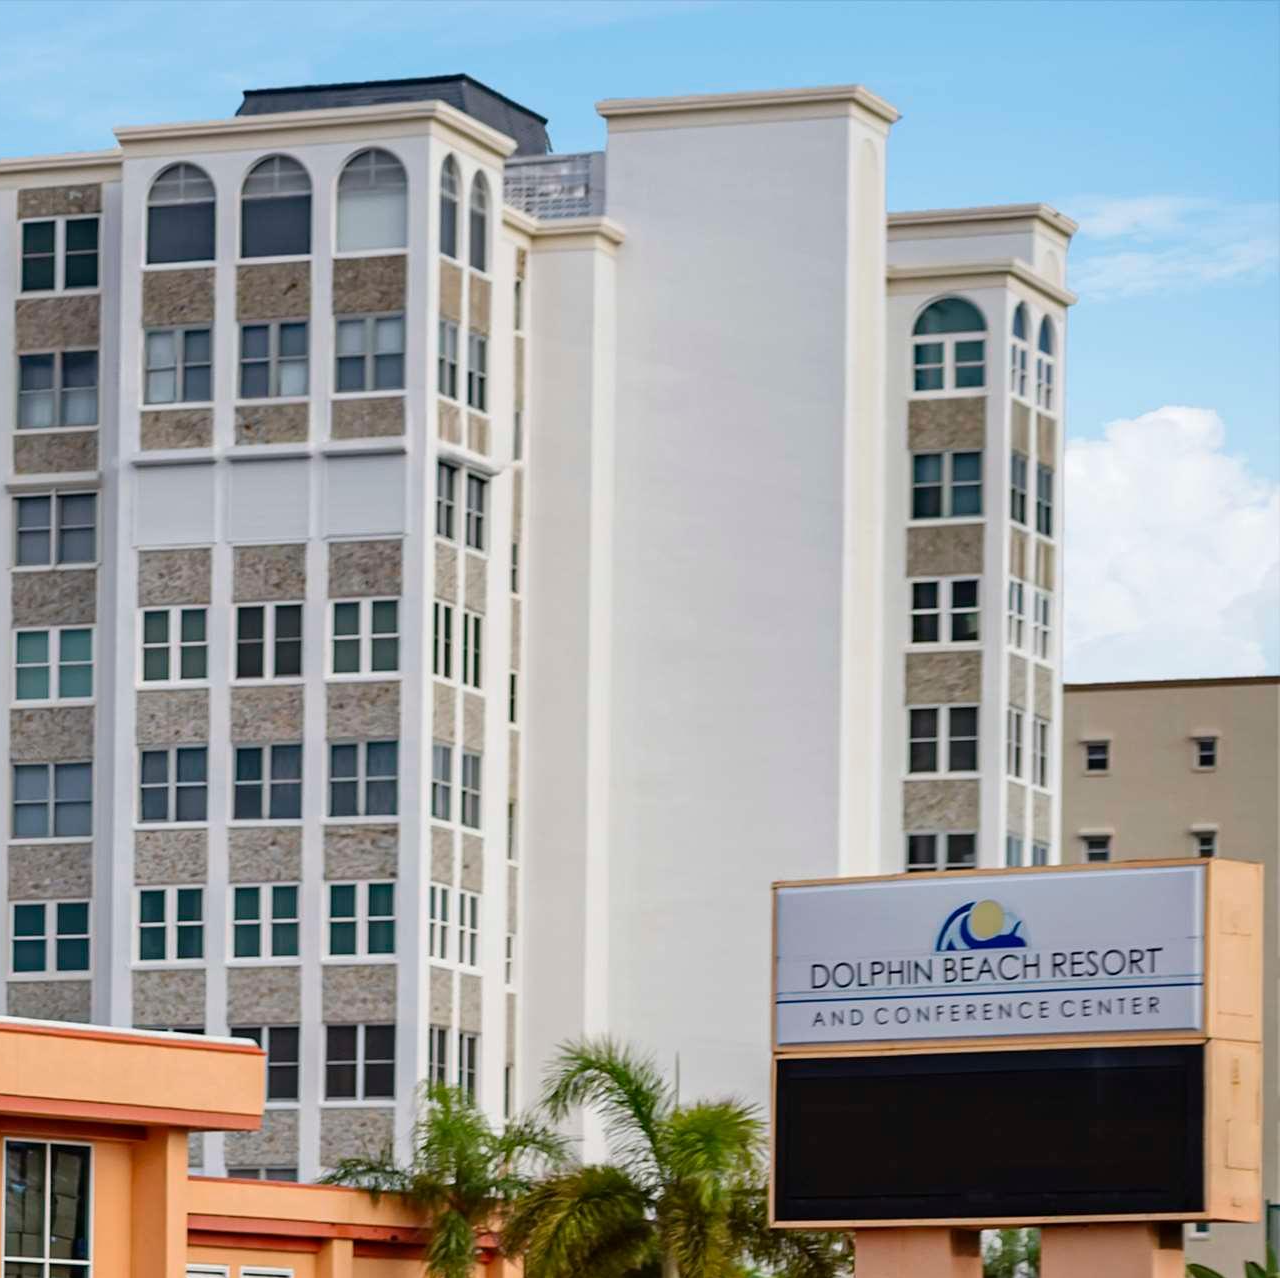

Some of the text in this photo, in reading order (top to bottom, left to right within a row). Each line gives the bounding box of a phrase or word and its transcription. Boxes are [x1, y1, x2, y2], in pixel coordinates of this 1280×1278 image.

[810, 947, 1164, 990] DOLPHIN BEACH RESORT
[811, 996, 1161, 1028] AND CONFERENCE CENTER
